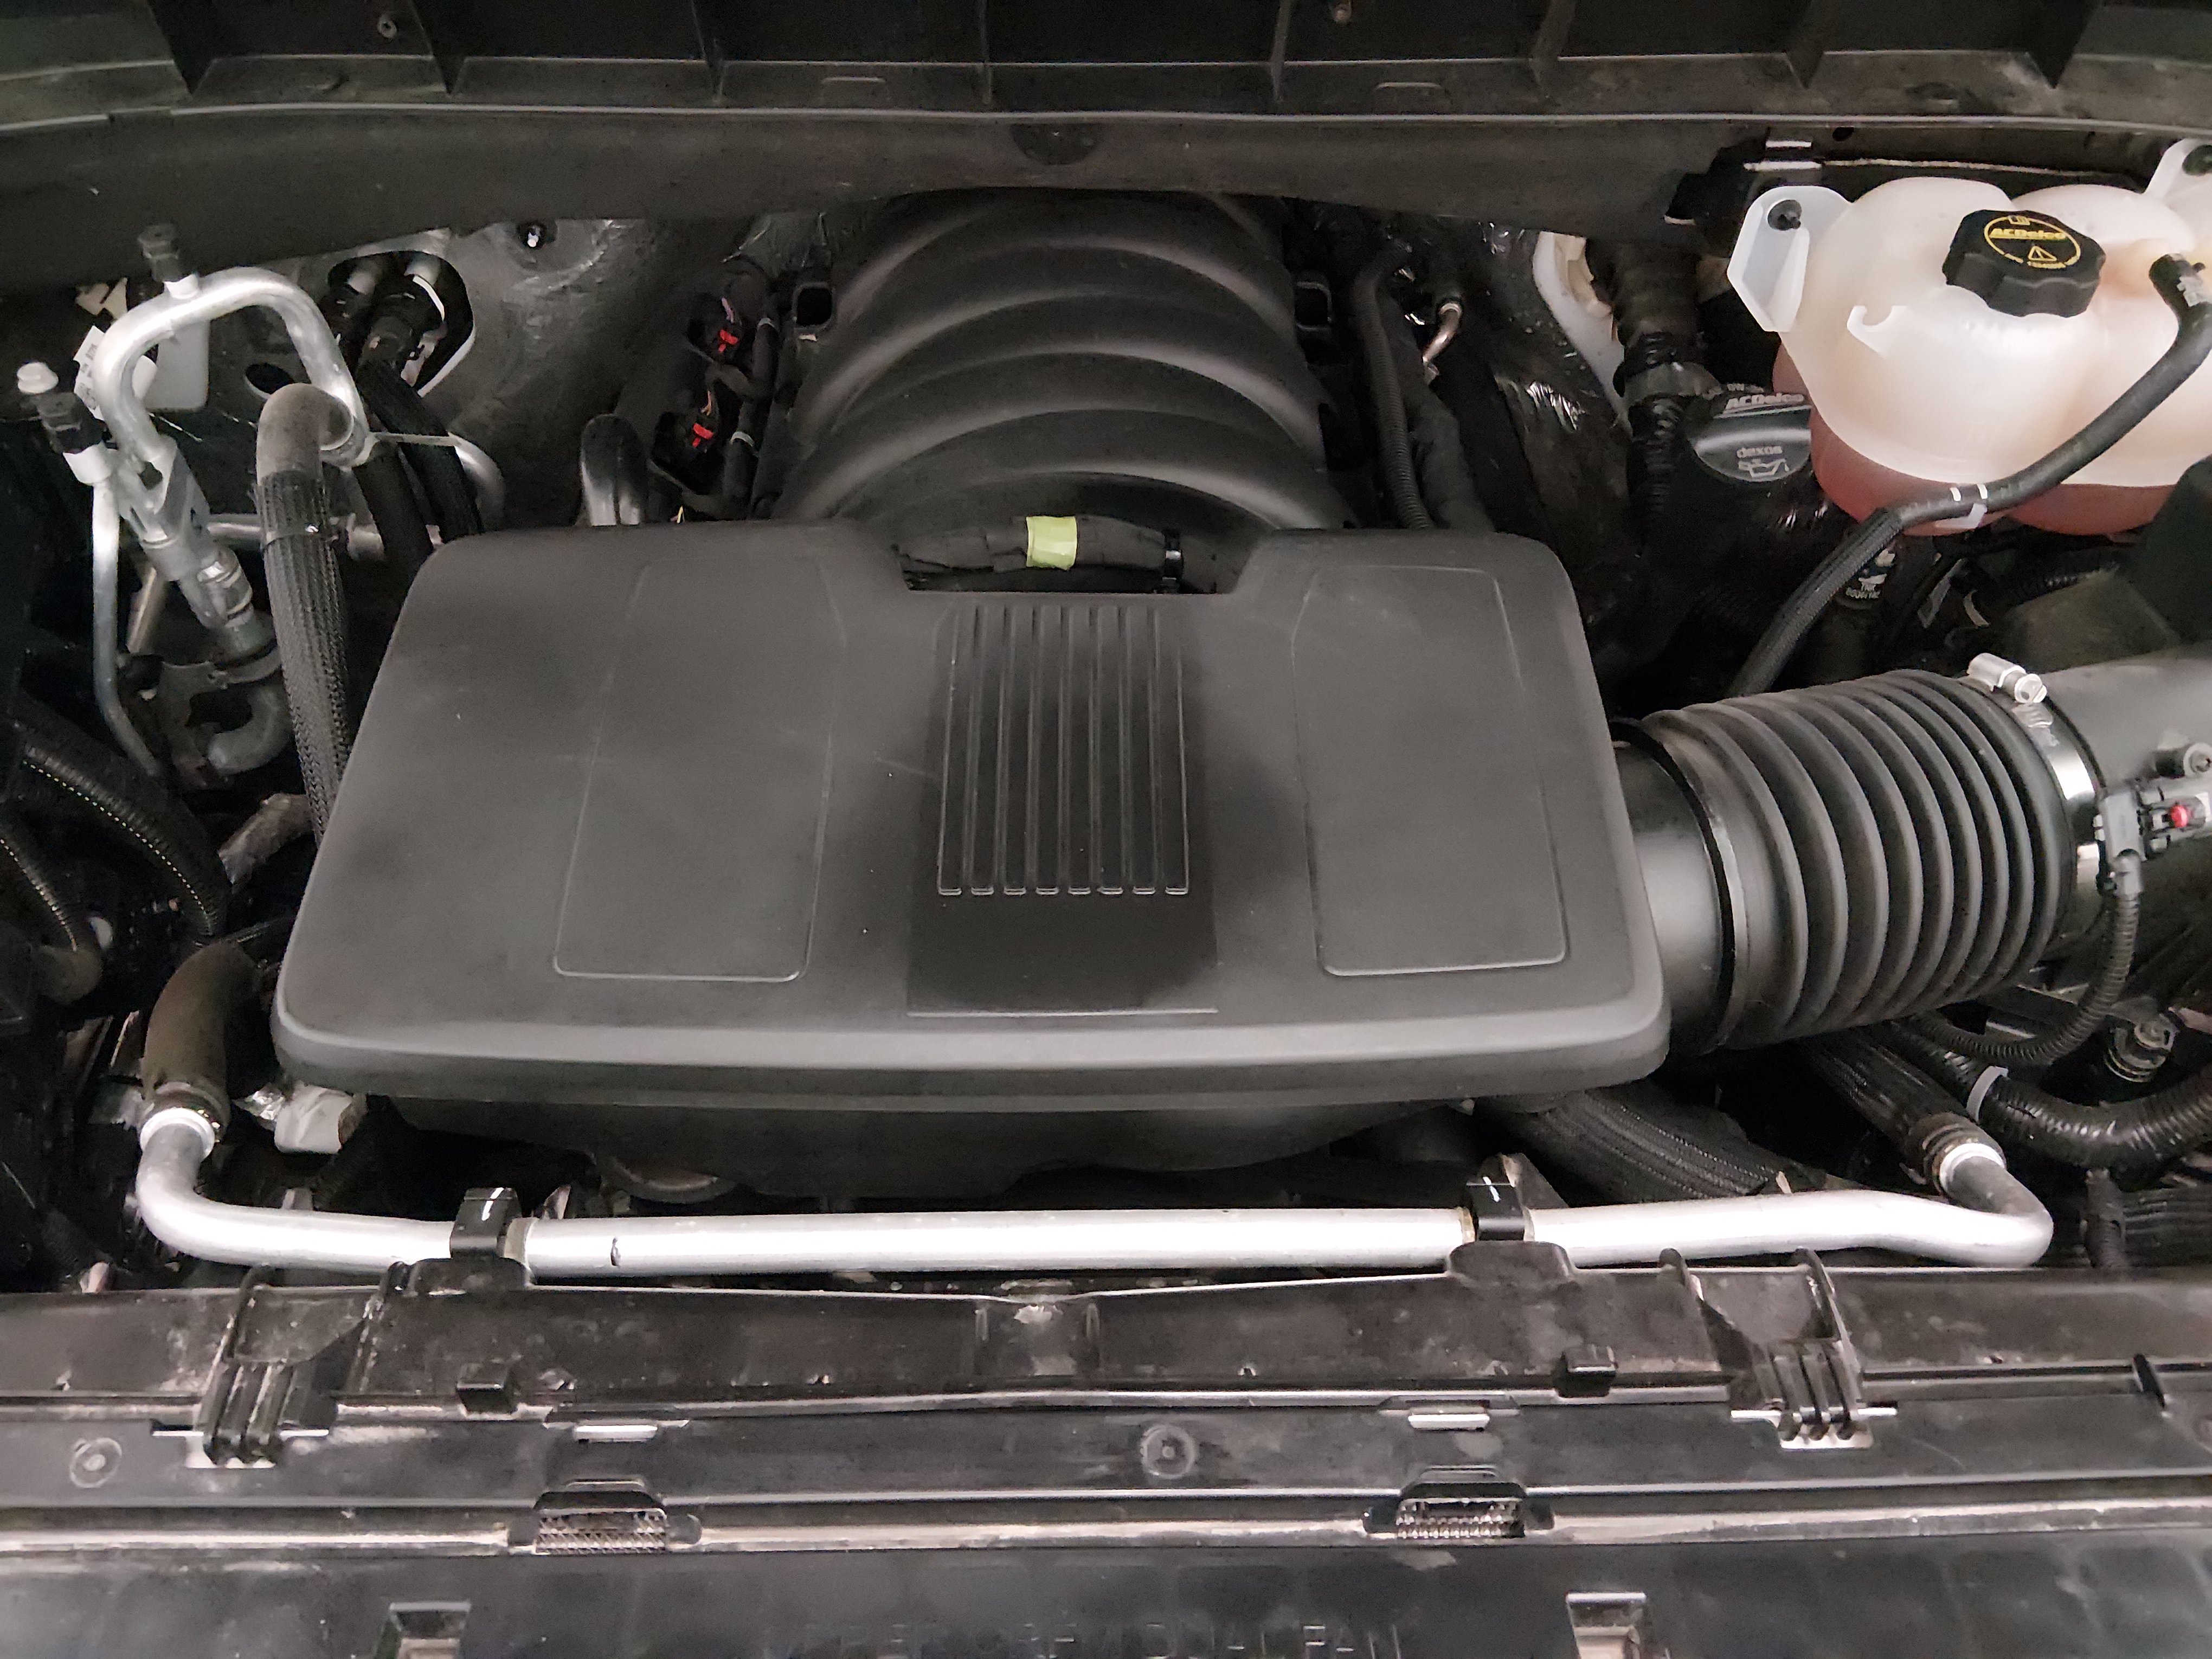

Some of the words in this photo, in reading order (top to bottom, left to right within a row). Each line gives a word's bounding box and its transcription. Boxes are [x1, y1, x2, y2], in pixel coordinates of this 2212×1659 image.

[1989, 228, 2066, 239] ACDelco
[1725, 393, 1804, 411] ACDelco
[1737, 446, 1783, 458] dexos
